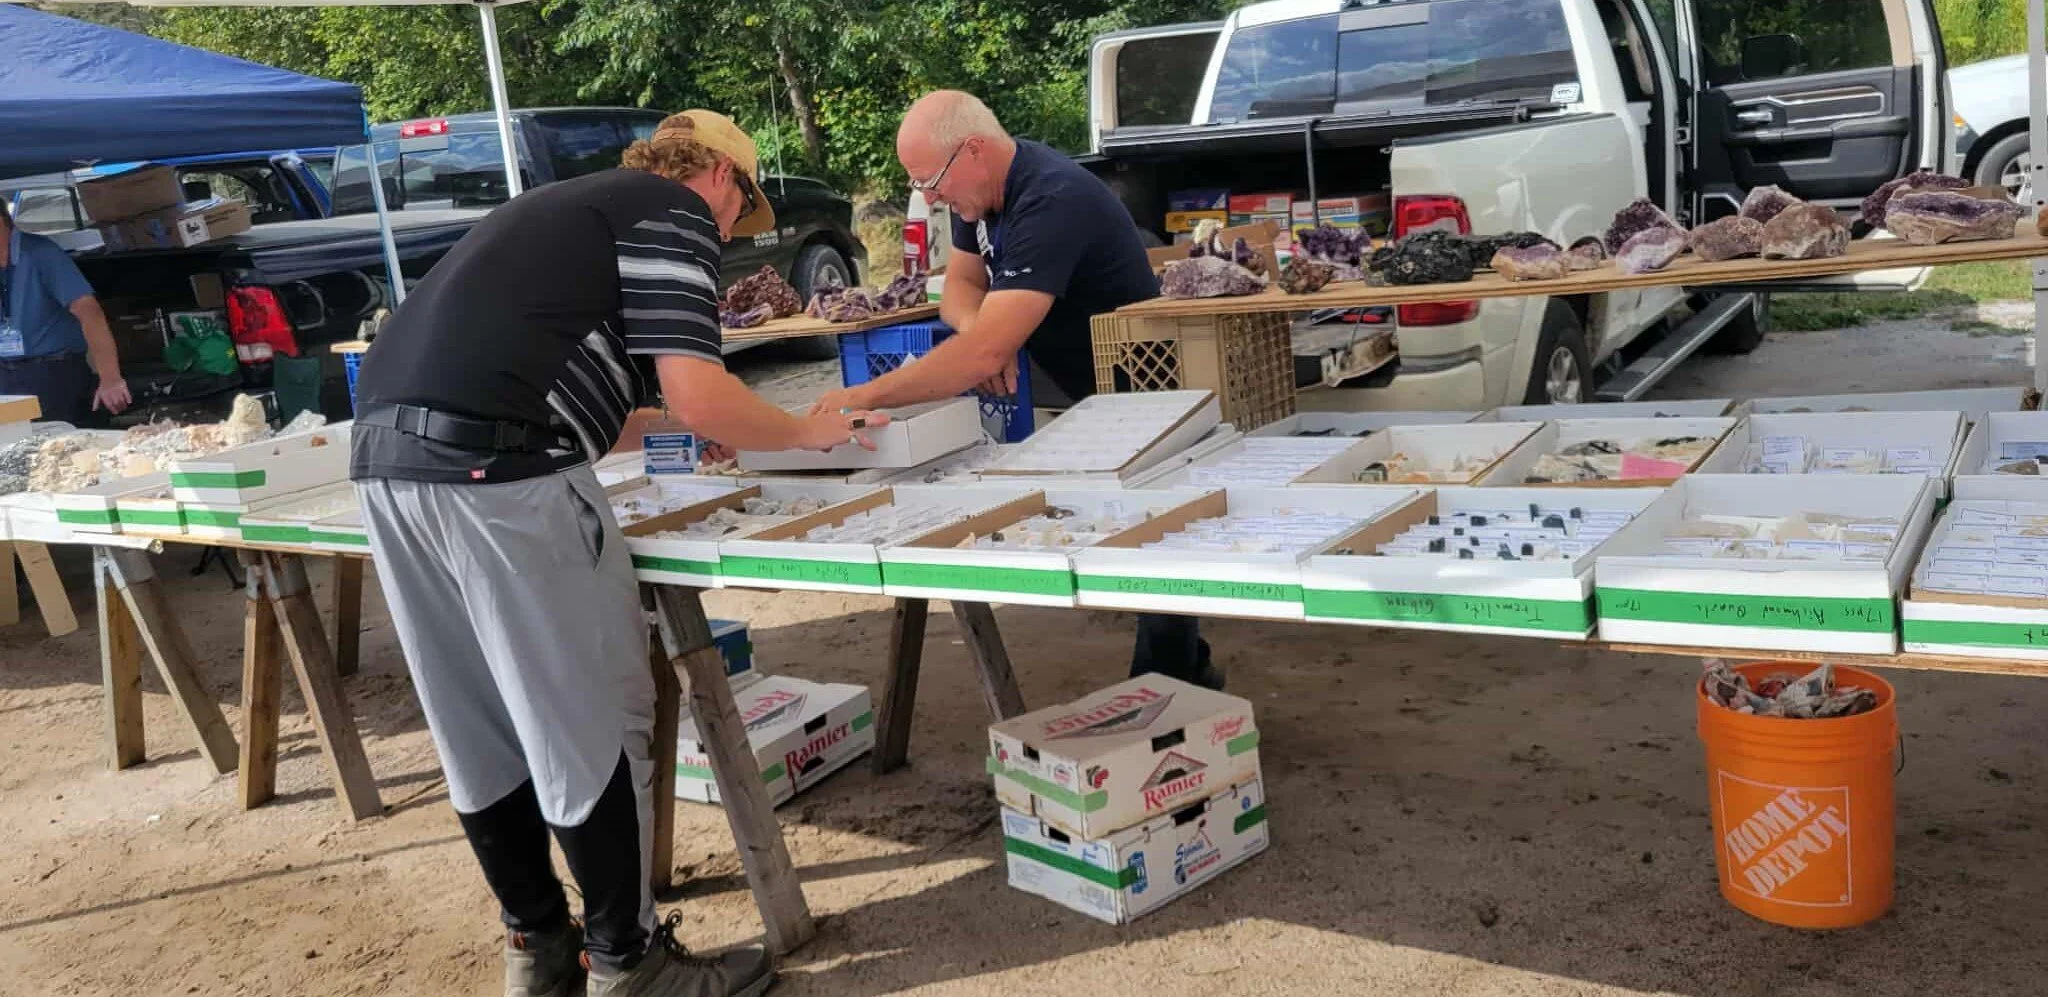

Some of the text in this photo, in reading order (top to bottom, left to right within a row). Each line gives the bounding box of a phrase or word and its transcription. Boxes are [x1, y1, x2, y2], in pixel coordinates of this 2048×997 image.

[785, 722, 850, 780] Rainier
[1143, 771, 1206, 812] Rainier
[1725, 787, 1816, 865] HOME
[1744, 805, 1846, 898] DEPOT
